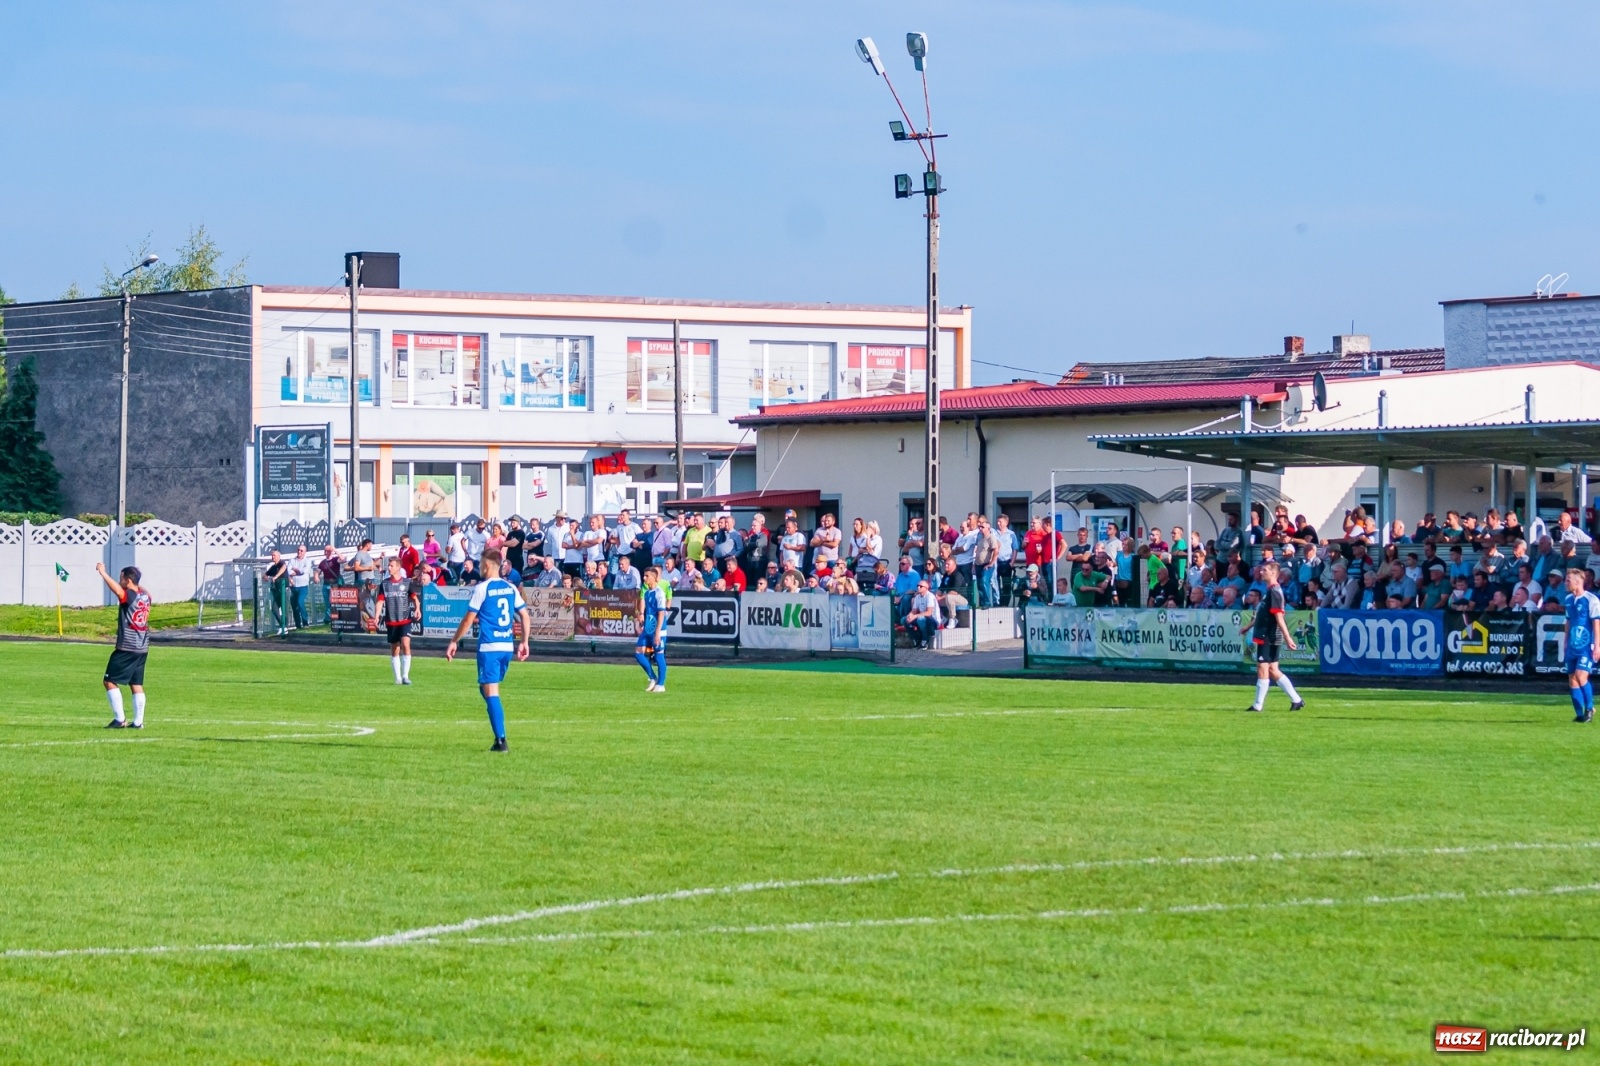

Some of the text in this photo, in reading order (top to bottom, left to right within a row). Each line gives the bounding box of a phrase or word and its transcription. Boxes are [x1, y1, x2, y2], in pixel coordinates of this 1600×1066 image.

[867, 347, 904, 357] PRODUCENT
[876, 357, 896, 366] MEBLI
[425, 604, 451, 612] INTERNET
[497, 597, 510, 627] 3
[747, 603, 823, 629] KERAKOLL
[603, 614, 636, 635] szefa
[1169, 623, 1225, 638] MŁODEGO
[869, 630, 890, 638] FENSTER
[1030, 626, 1092, 643] PIŁKARSKA
[1101, 629, 1165, 645] AKADEMIA
[1489, 633, 1524, 642] BUDUJEMY
[1169, 638, 1242, 654] LKS-u Tworków
[1489, 646, 1500, 655] OD
[1507, 646, 1518, 655] DO
[1446, 660, 1524, 675] tel. 665 092 363
